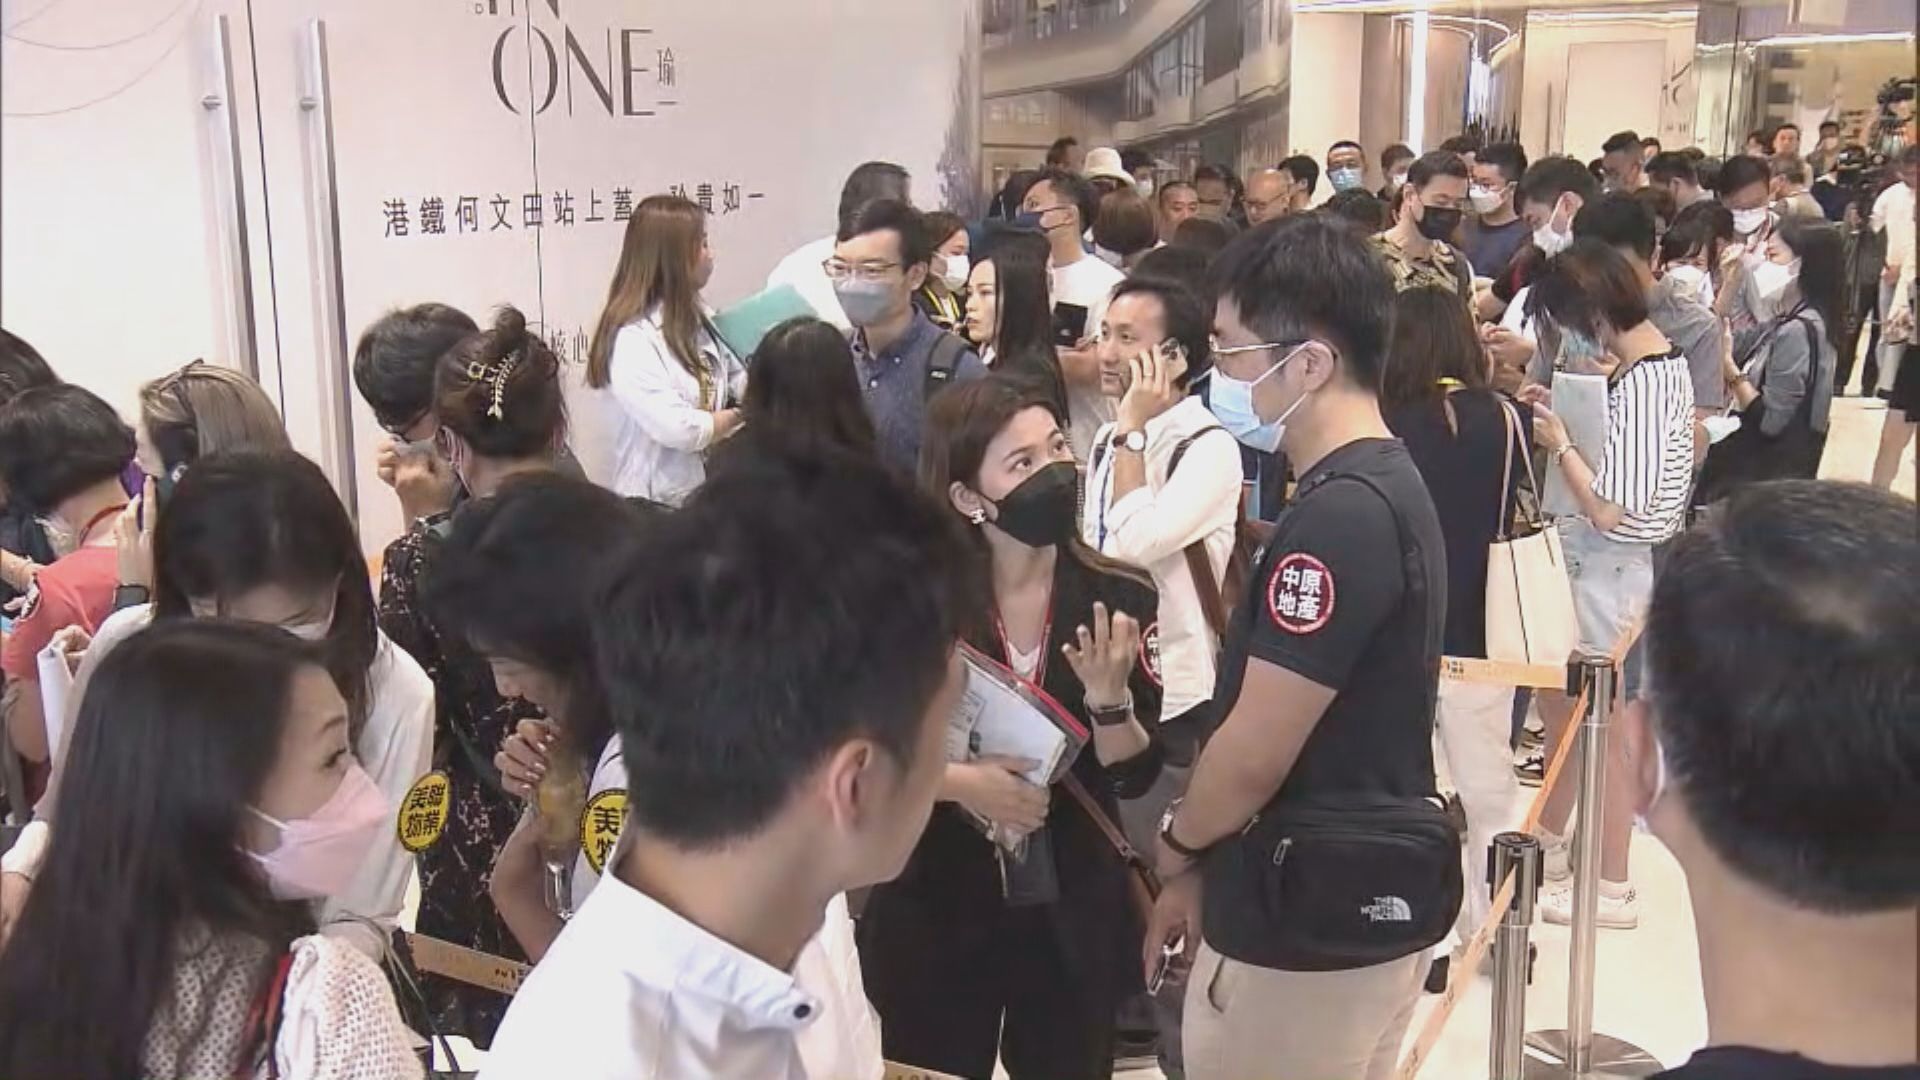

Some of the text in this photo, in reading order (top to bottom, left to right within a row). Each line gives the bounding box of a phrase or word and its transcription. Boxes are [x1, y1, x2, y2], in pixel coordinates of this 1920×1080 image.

[492, 24, 656, 118] ONE
[382, 185, 633, 238] 港鐵何文田站上蓋
[1282, 565, 1324, 595] 中原
[1276, 588, 1322, 621] 地產
[409, 783, 446, 811] 美聯
[405, 809, 441, 838] 物業
[592, 804, 629, 836] 美
